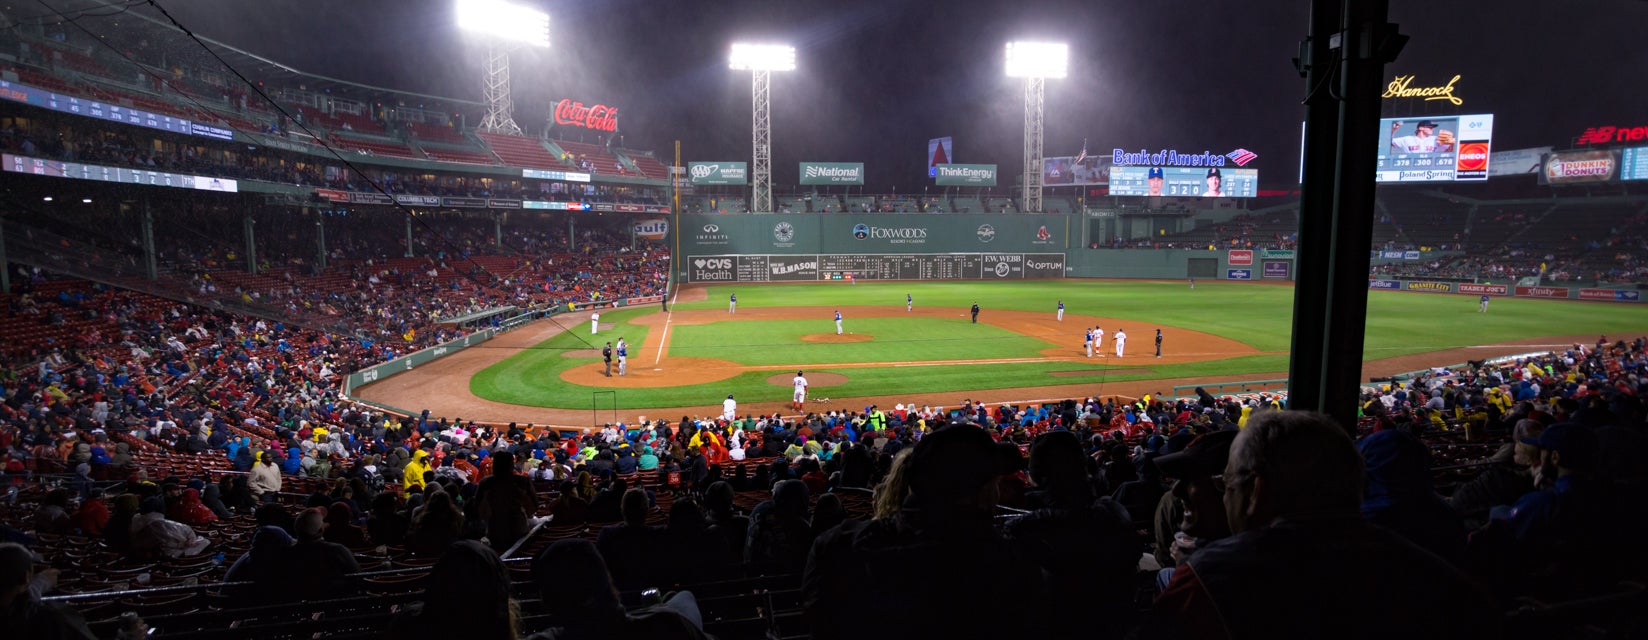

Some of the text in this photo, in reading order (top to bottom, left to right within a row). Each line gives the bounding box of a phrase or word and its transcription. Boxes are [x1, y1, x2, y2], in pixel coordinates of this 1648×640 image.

[1382, 75, 1463, 105] Hancock
[1113, 149, 1225, 166] Bank of America
[1436, 158, 1453, 166] .678
[1566, 160, 1611, 169] DUNKIN'
[817, 166, 858, 177] National
[939, 166, 992, 179] ThinkEnergy
[1400, 171, 1426, 179] Poland
[1426, 171, 1454, 180] Spring
[1565, 167, 1607, 176] DONUTS
[134, 174, 140, 182] 3
[150, 176, 155, 184] 2
[1171, 186, 1199, 195] 3 2 0
[634, 222, 666, 233] Gulf
[871, 226, 927, 239] FOXWOODS
[1384, 251, 1402, 259] NESN
[707, 258, 732, 269] CVS
[1035, 262, 1062, 270] OPTUM
[696, 270, 732, 280] Health
[1435, 282, 1450, 291] CITY
[1527, 287, 1555, 296] xfinity
